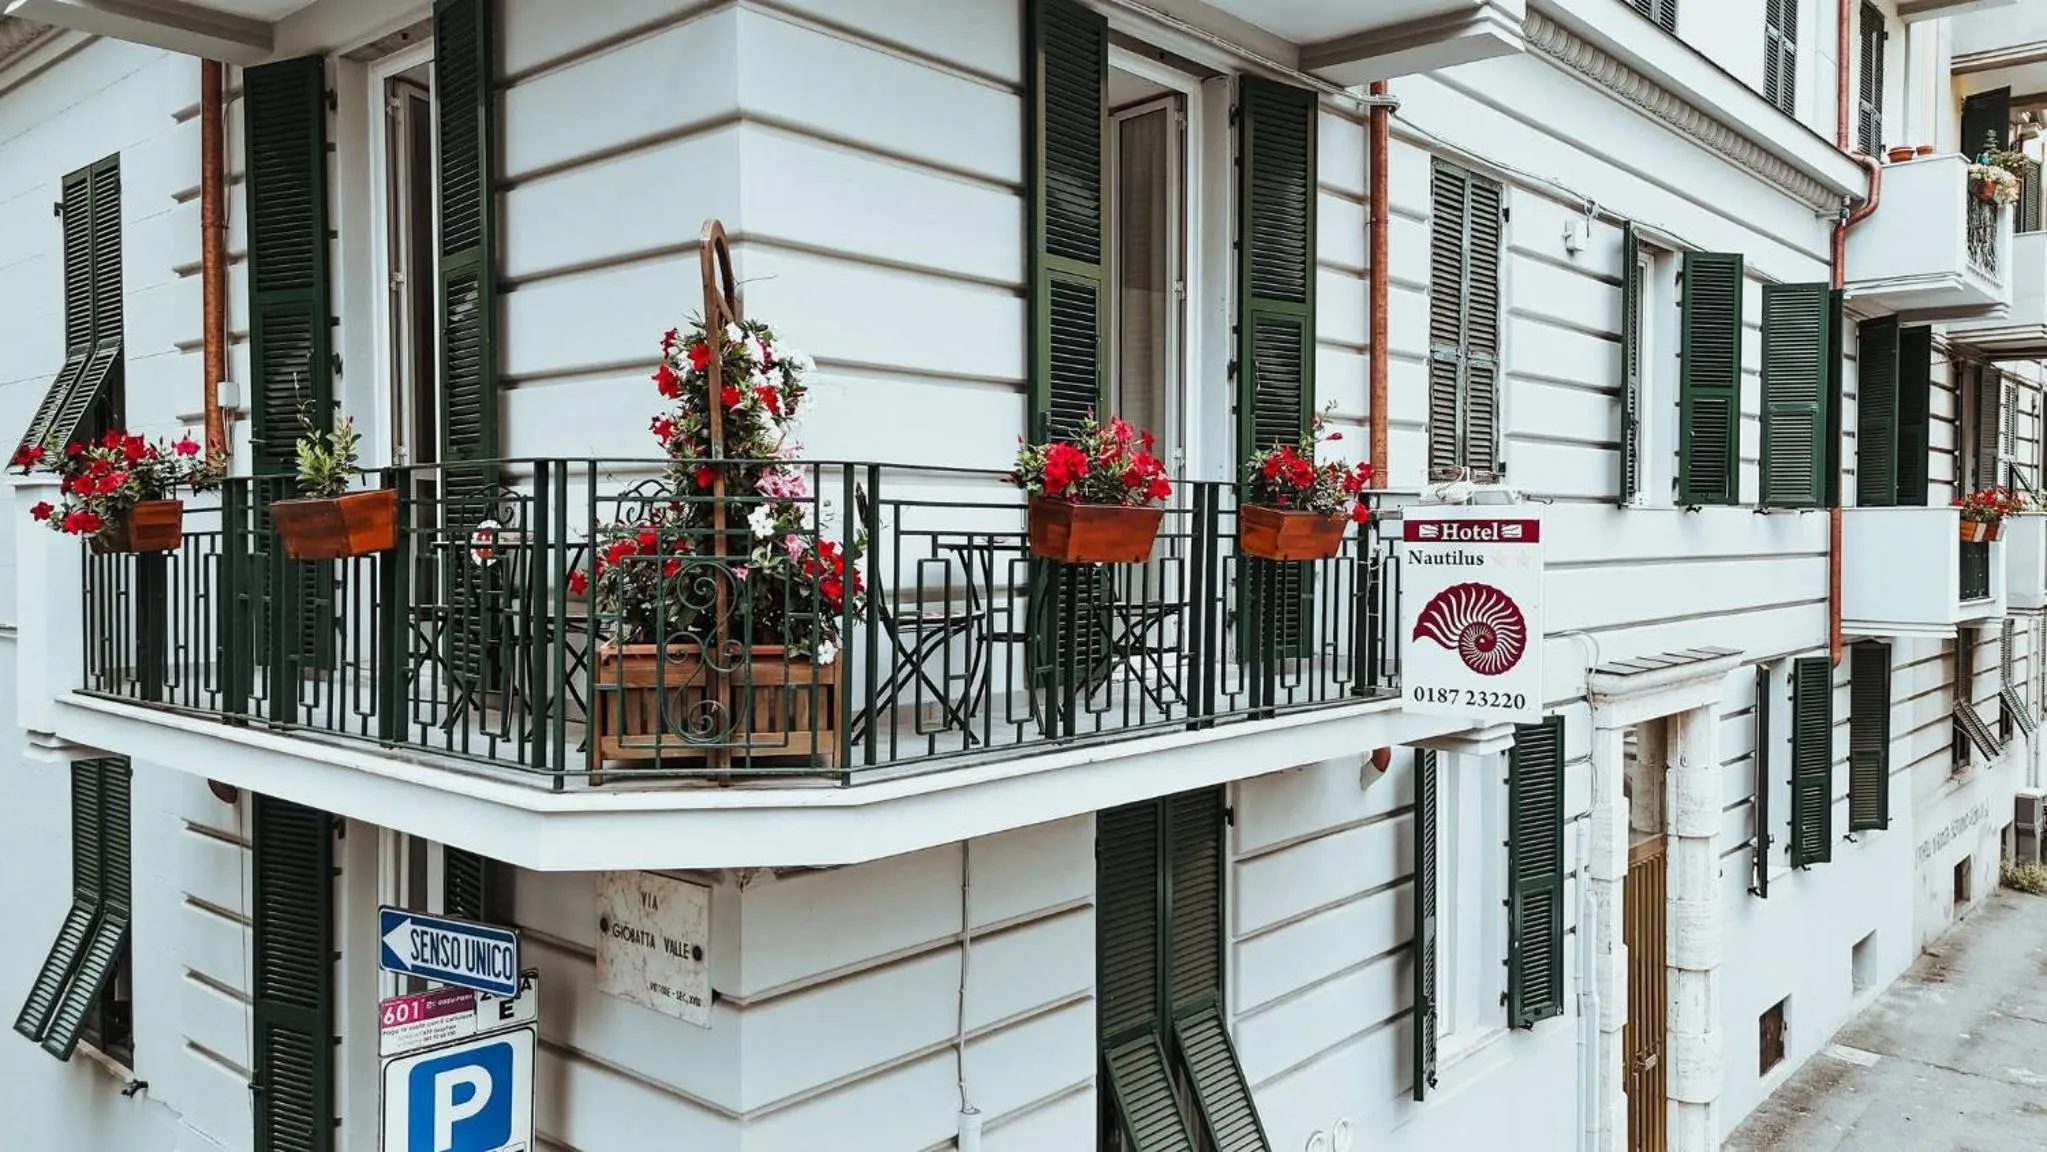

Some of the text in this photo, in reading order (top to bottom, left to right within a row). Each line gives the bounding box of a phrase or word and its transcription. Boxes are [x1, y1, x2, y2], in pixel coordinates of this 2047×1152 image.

[1441, 522, 1499, 540] Hotel
[1408, 549, 1484, 566] Nautilus
[1414, 686, 1526, 710] 0187 23220
[641, 891, 658, 911] VIA
[410, 928, 513, 980] SENSO UNICO
[663, 937, 689, 960] VALLE
[383, 1001, 419, 1025] 601
[499, 998, 514, 1020] E
[434, 1064, 493, 1151] P
